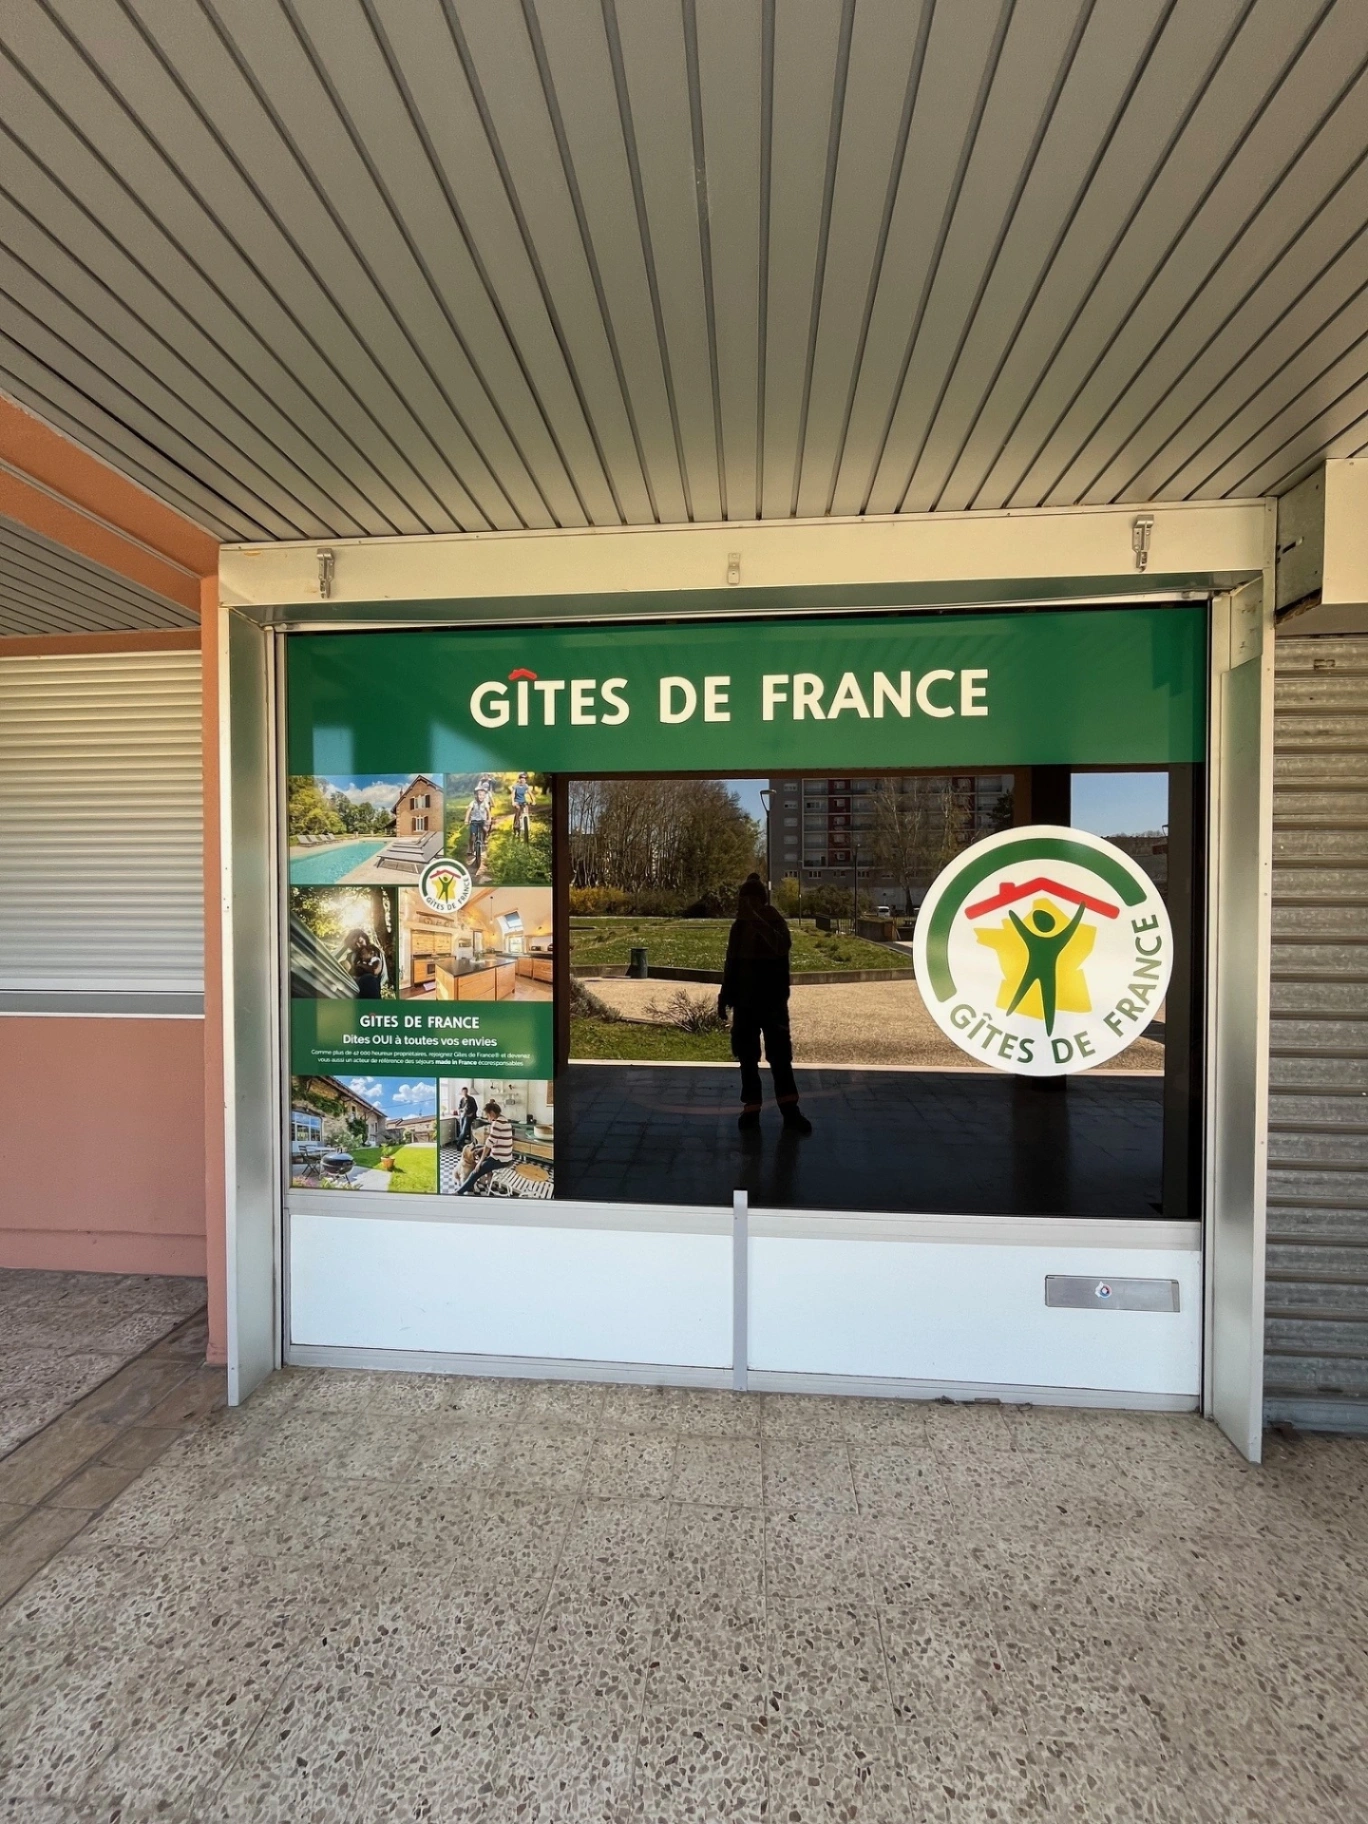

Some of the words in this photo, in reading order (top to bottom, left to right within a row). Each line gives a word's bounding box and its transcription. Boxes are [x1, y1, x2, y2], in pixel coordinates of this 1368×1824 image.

[470, 668, 630, 729] GÎTES
[660, 676, 731, 724] DE
[762, 668, 988, 721] FRANCE
[426, 896, 445, 911] GÎTES
[447, 903, 456, 911] DE
[457, 878, 471, 904] FRANCE
[950, 1003, 1035, 1064] GÎTES
[1051, 1030, 1096, 1064] DE
[1102, 914, 1162, 1038] FRANCE
[404, 1016, 422, 1028] DE
[428, 1016, 480, 1028] FRANCE
[343, 1034, 370, 1044] Dites
[372, 1035, 392, 1044] OUI
[395, 1034, 402, 1045] à
[404, 1036, 439, 1045] toutes
[440, 1037, 459, 1046] vos
[461, 1036, 497, 1047] envies
